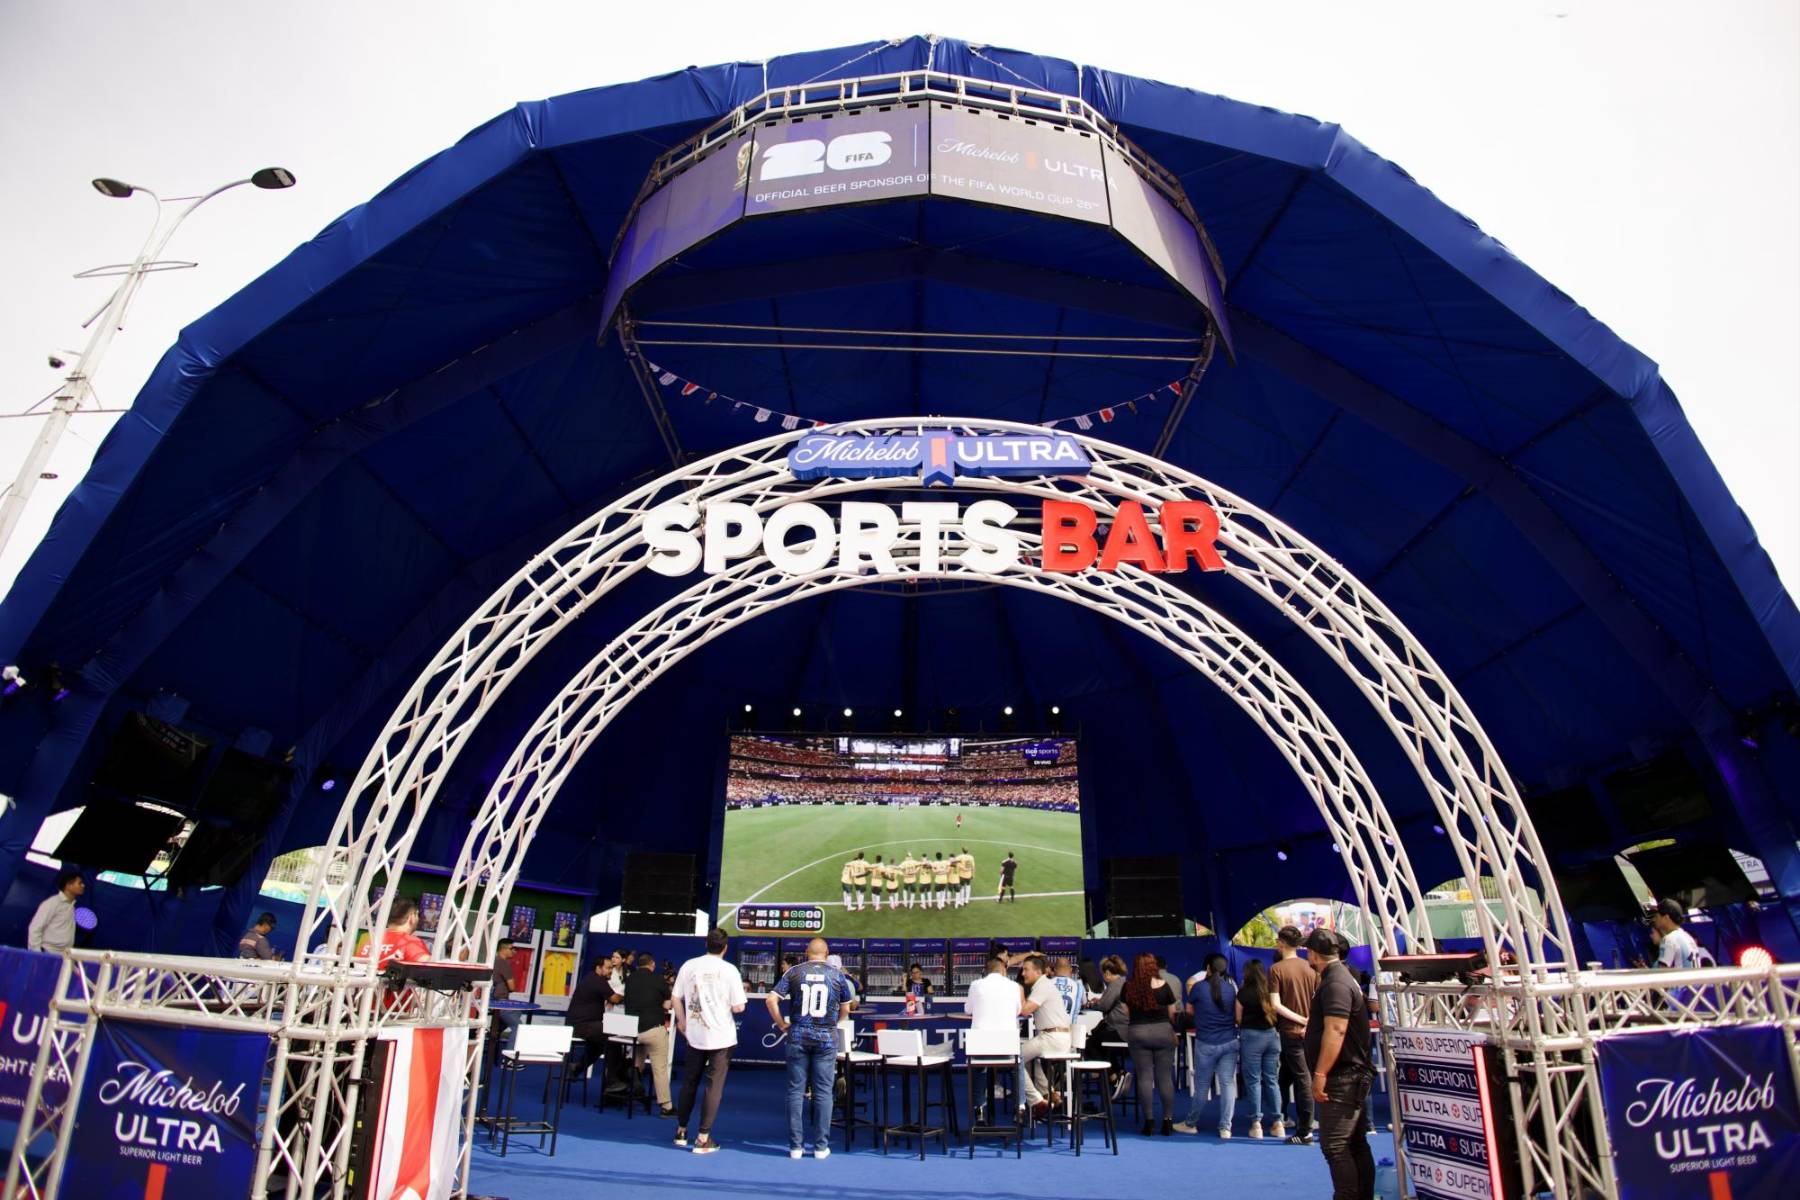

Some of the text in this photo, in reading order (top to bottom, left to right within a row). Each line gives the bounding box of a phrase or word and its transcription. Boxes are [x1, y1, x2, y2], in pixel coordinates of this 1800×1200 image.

[760, 131, 893, 180] 26
[845, 152, 874, 163] FIFA
[937, 138, 1120, 192] Michelob ULTRA
[755, 188, 810, 203] OFFICIAL
[814, 183, 847, 196] BEER
[850, 175, 913, 191] SPONSOR
[917, 173, 936, 184] OF
[941, 175, 965, 187] THE
[969, 179, 995, 191] FIFA
[999, 183, 1045, 200] WORLD
[1048, 193, 1073, 205] CUP
[795, 437, 1082, 463] Michelob ULTRA
[642, 499, 1227, 577] SPORTS BAR
[1039, 748, 1058, 756] sports
[801, 984, 828, 1017] 10
[1425, 1037, 1472, 1054] SUPERIOR
[99, 1061, 246, 1117] Michelob
[1418, 1068, 1469, 1089] SUPERIOR
[1411, 1098, 1450, 1117] ULTRA
[1626, 1072, 1775, 1127] Michelob
[115, 1113, 224, 1153] ULTRA
[1407, 1130, 1447, 1150] ULTRA
[1655, 1120, 1773, 1160] ULTRA
[119, 1145, 202, 1165] SUPERIOR LIGHT BEER
[1669, 1154, 1757, 1173] SUPERIOR LIGHT BEER
